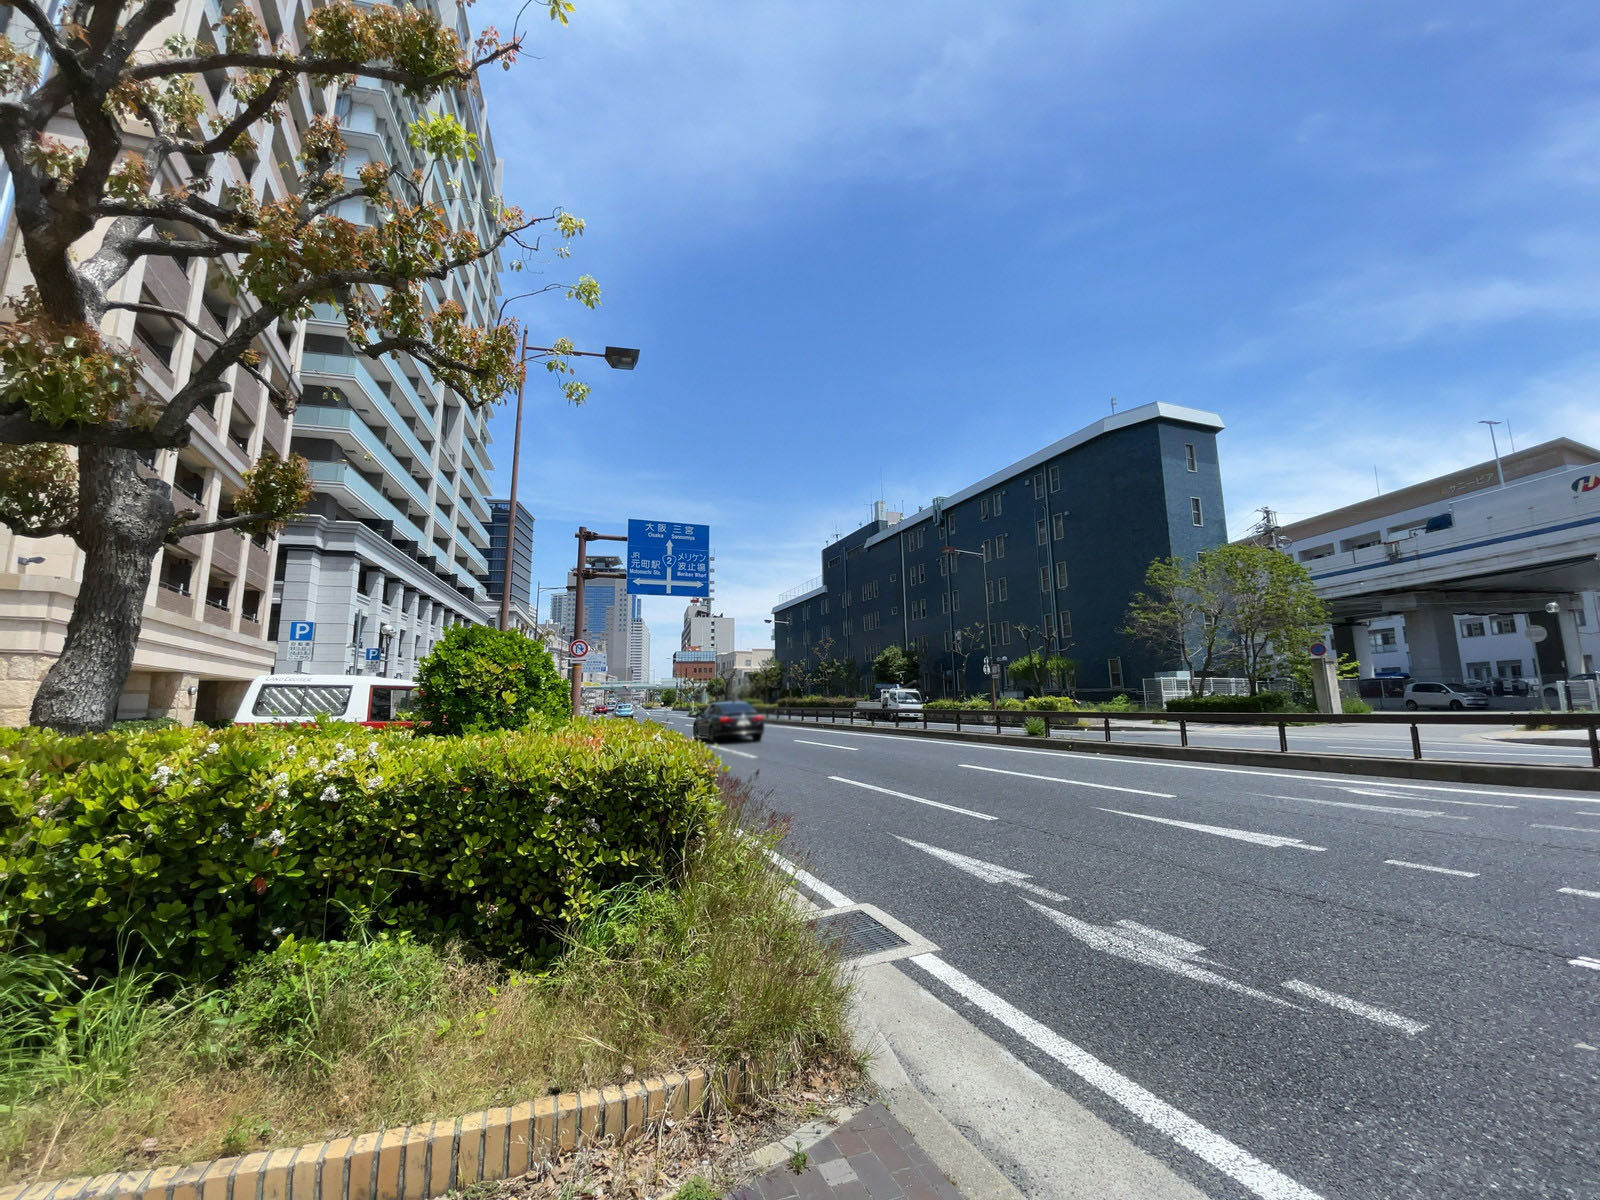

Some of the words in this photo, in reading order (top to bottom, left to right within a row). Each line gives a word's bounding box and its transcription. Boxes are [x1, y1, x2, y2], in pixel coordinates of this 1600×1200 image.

[646, 523, 667, 532] 大阪
[672, 525, 694, 535] 三宮
[678, 552, 706, 562] メリケン
[631, 559, 661, 569] 元町駅
[678, 562, 706, 572] 波止場
[295, 624, 310, 639] P
[369, 650, 378, 659] P
